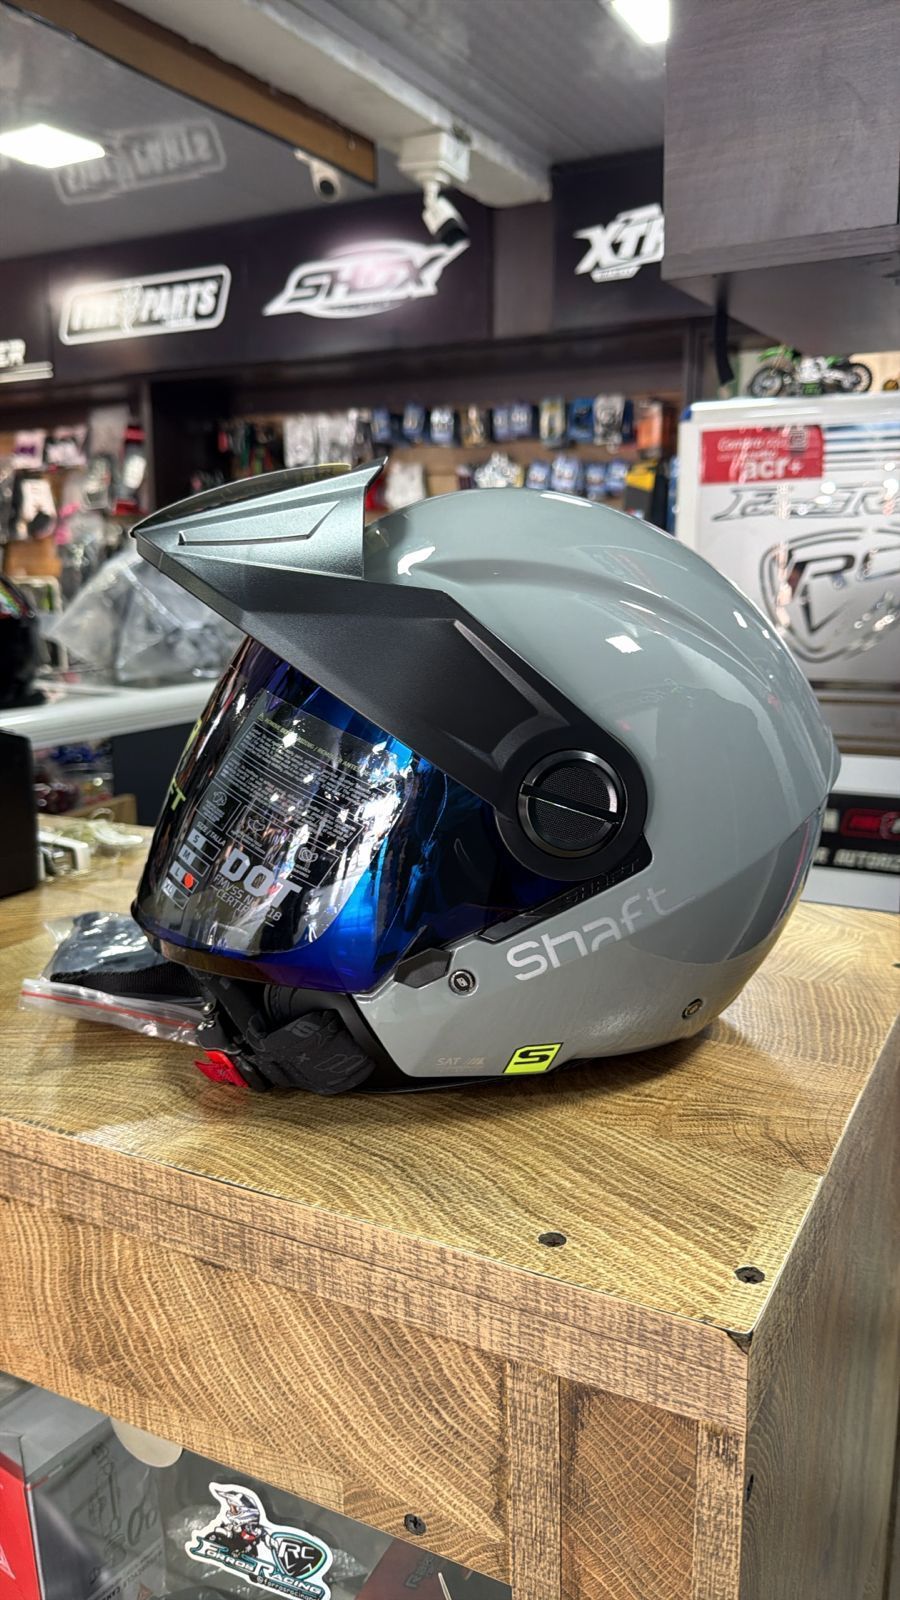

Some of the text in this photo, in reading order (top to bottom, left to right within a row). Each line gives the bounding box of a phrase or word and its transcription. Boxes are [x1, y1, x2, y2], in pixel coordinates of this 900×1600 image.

[193, 834, 201, 844] S
[182, 850, 192, 861] M
[213, 873, 245, 899] FMVSS
[219, 848, 304, 909] DOT
[506, 888, 696, 981] shaft
[251, 1560, 323, 1595] RACING
